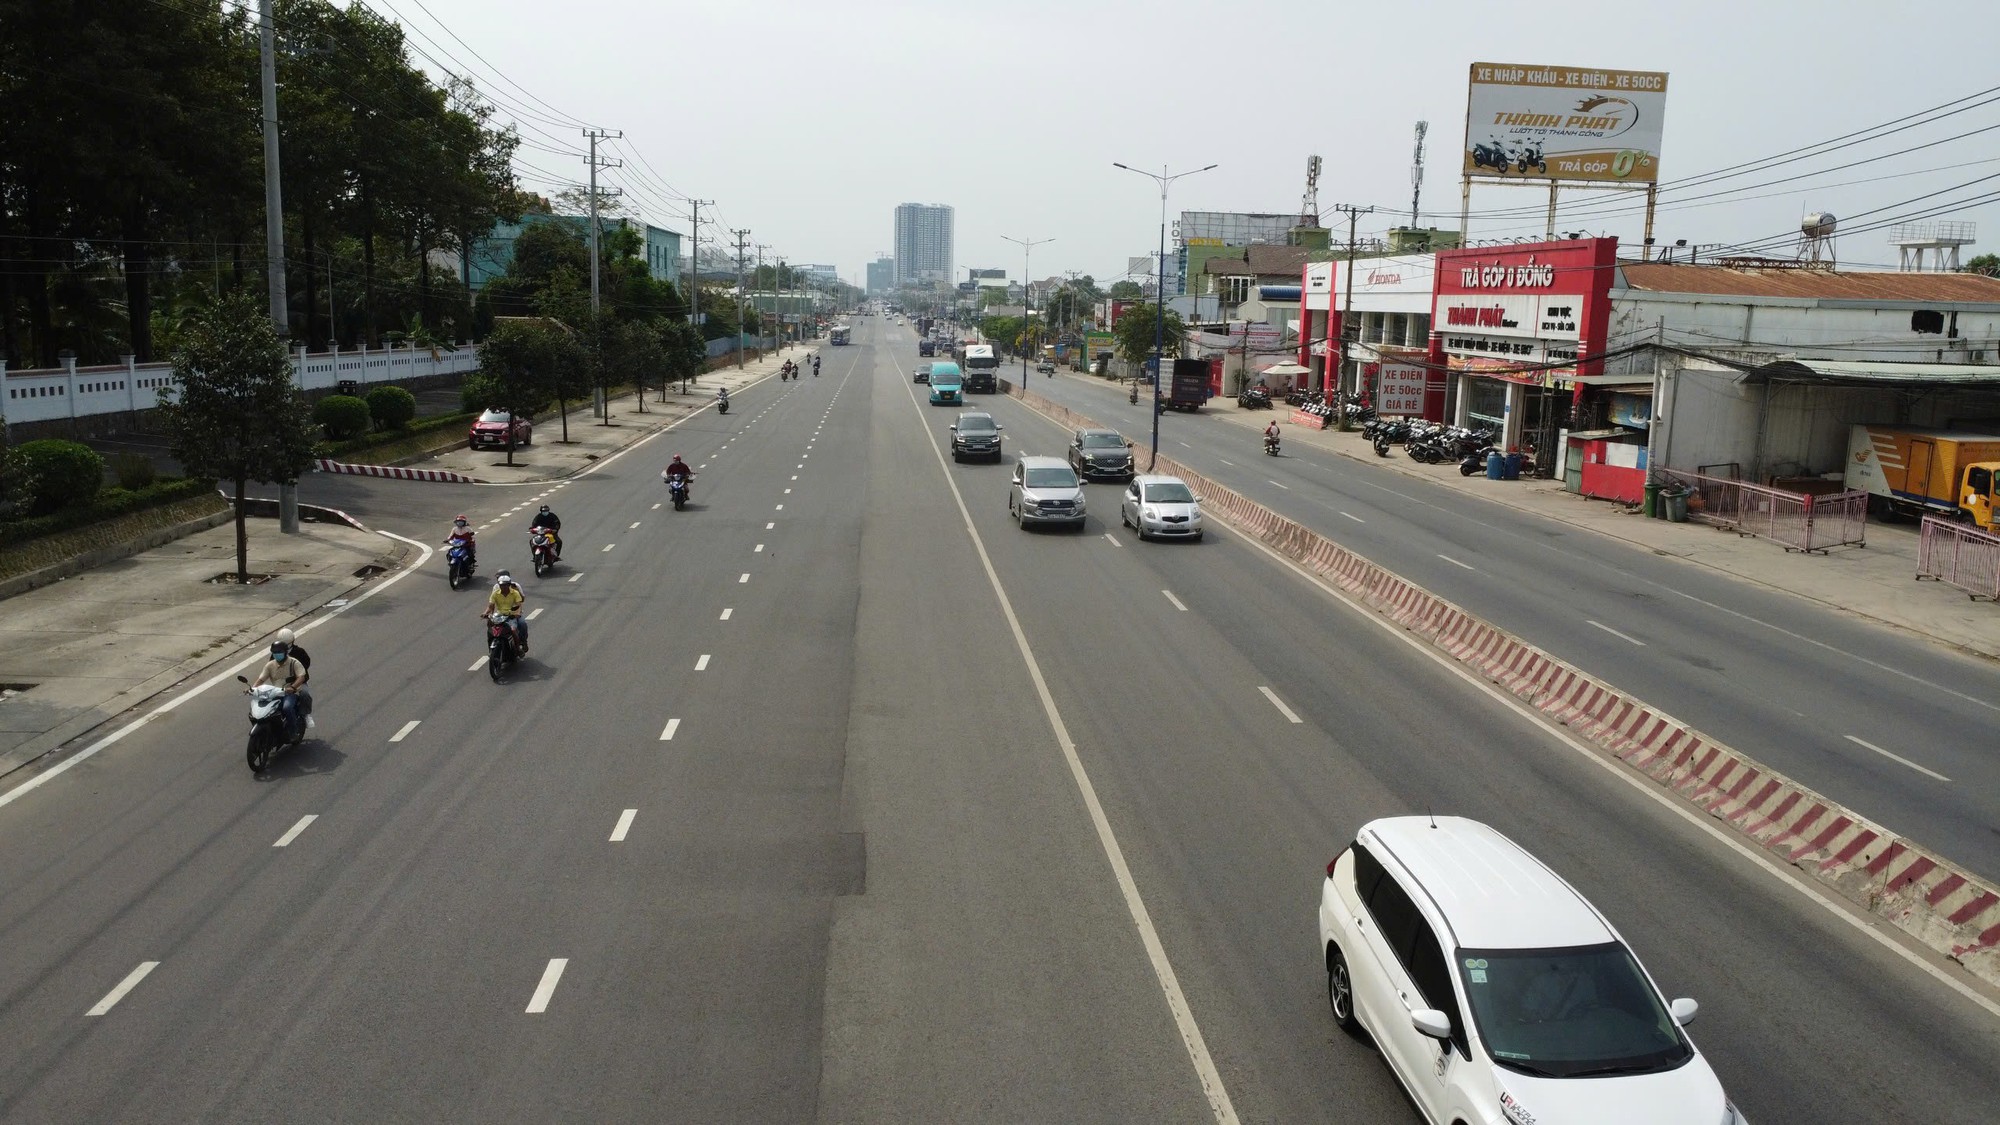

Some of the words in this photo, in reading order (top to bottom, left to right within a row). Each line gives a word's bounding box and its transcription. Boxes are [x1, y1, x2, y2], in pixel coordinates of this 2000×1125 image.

[1477, 68, 1491, 81] XE
[1494, 66, 1524, 85] NHẬP
[1527, 66, 1557, 84] KHẨU
[1565, 72, 1579, 85] XE
[1581, 70, 1608, 89] ĐIỆN
[1615, 74, 1629, 87] XE
[1631, 76, 1661, 89] 50CC
[1558, 158, 1581, 172] TRẢ
[1583, 160, 1608, 173] GÓP
[1461, 261, 1479, 288] TRẢ
[1482, 259, 1505, 287] GÓP
[1516, 254, 1553, 287] ĐỒNG
[1375, 273, 1401, 285] HONDA
[1385, 370, 1396, 380] XE
[1400, 368, 1422, 382] ĐIỆN
[1383, 385, 1396, 394] XE
[1398, 385, 1422, 395] 50cc
[1385, 397, 1402, 410] GIÁ
[1405, 397, 1418, 410] RẺ
